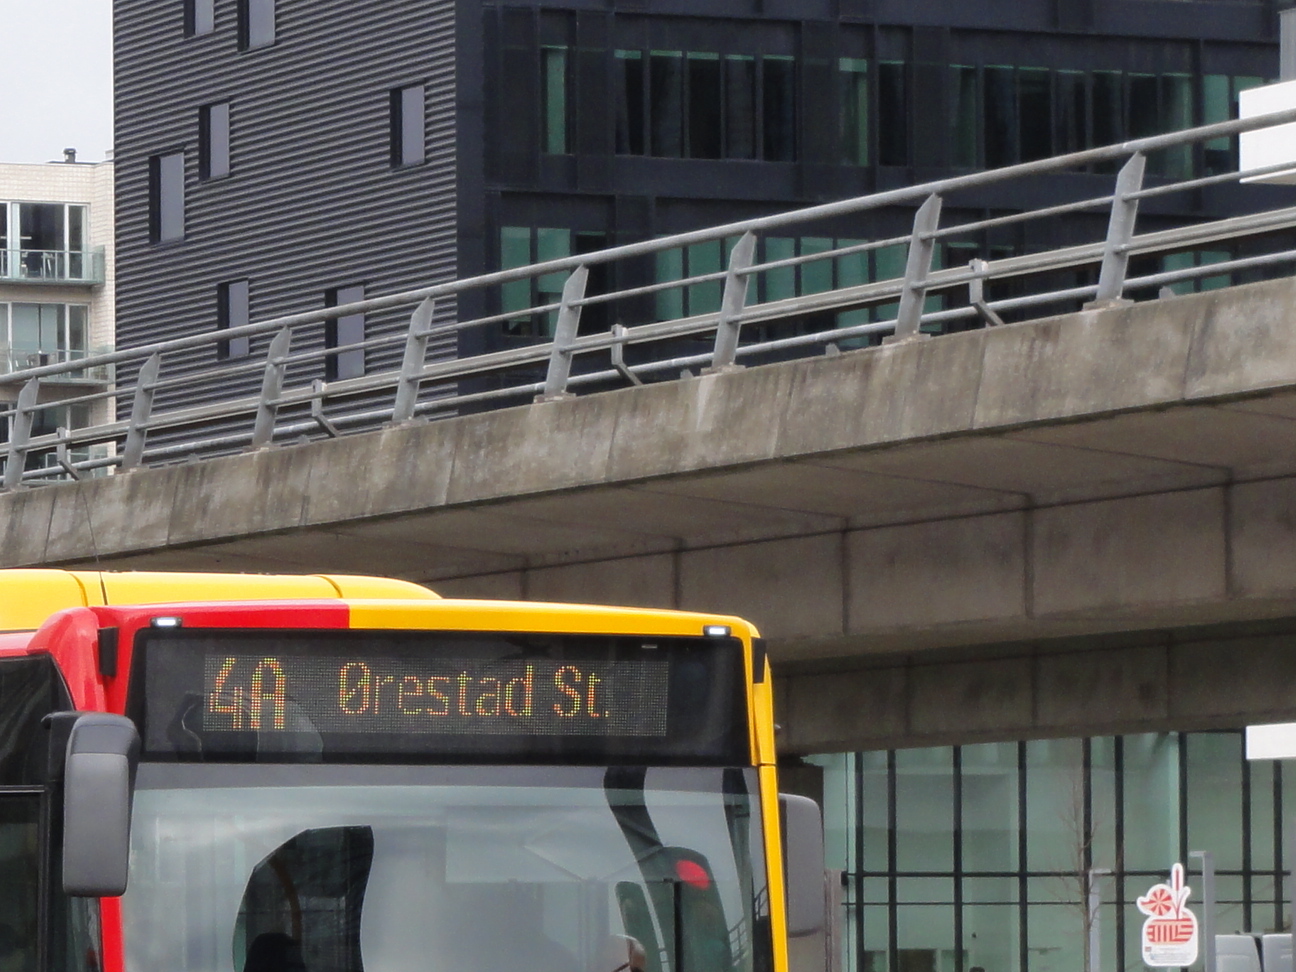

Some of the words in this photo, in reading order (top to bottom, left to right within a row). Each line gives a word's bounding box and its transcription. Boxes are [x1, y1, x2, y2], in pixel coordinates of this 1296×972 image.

[209, 657, 286, 729] 4A
[339, 661, 532, 717] Ørestad
[553, 665, 610, 718] St.
